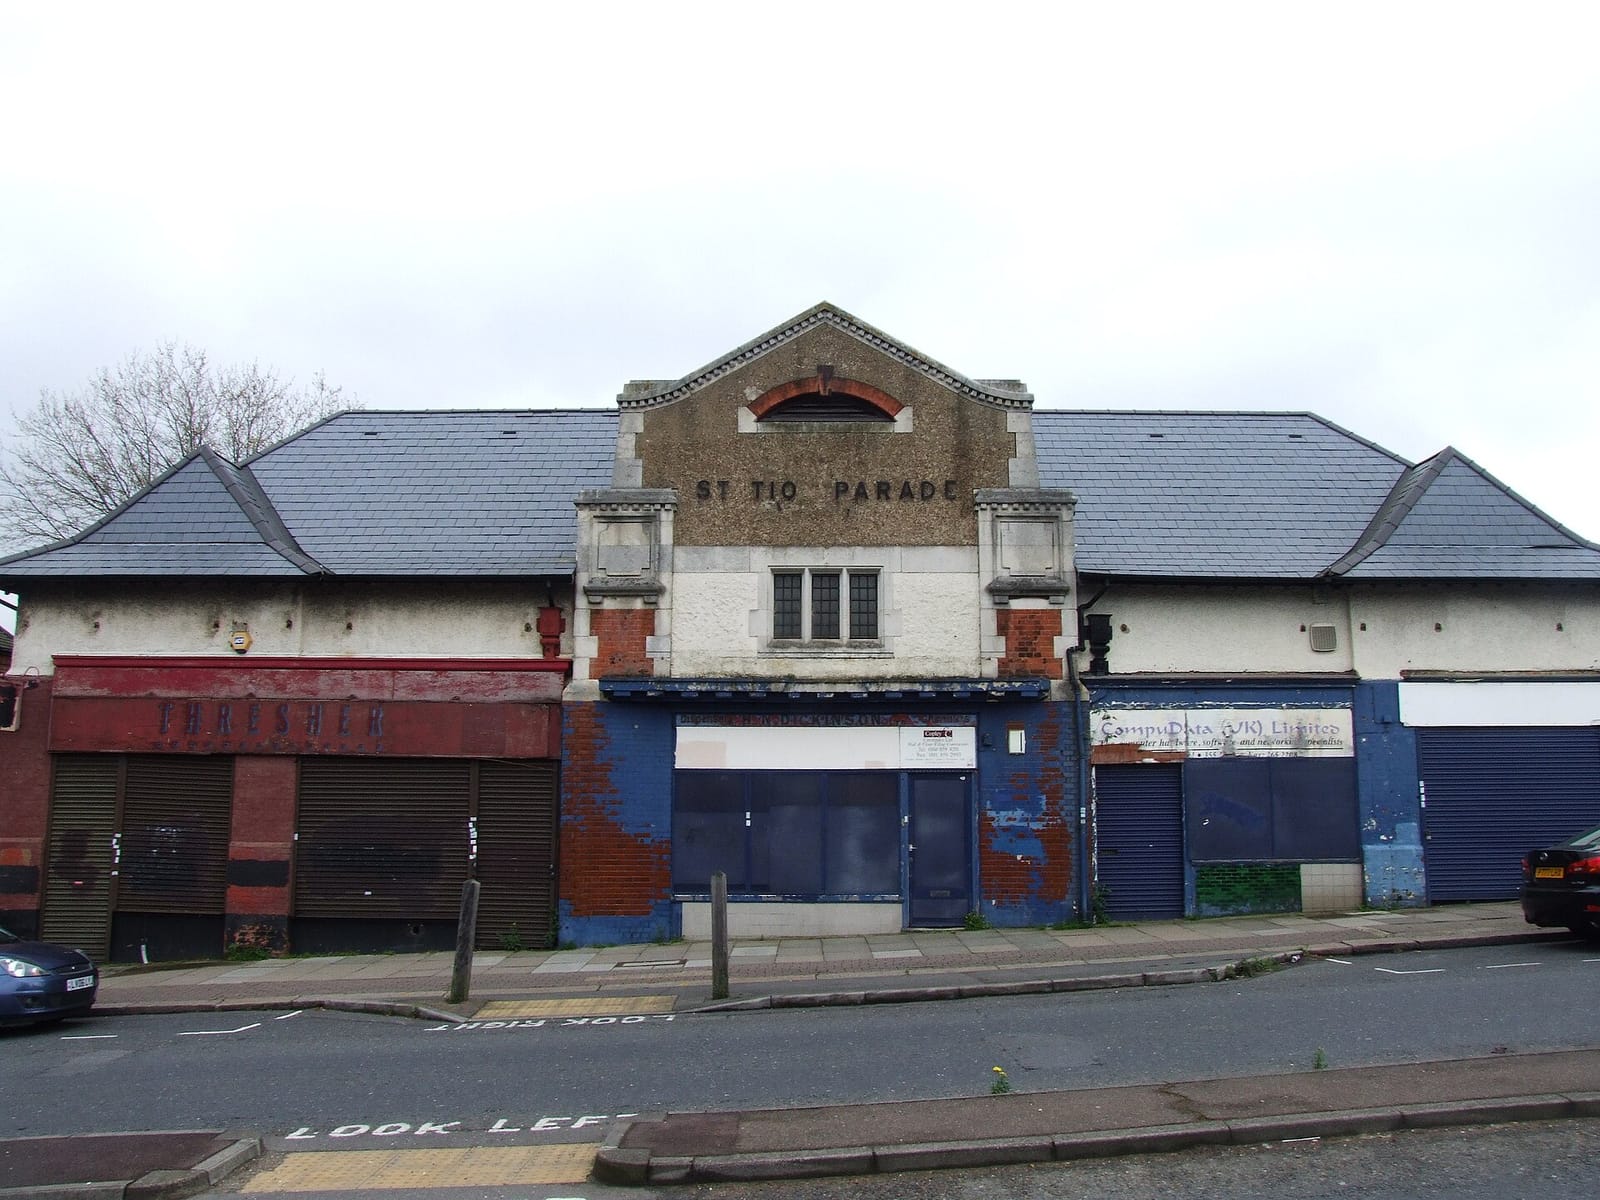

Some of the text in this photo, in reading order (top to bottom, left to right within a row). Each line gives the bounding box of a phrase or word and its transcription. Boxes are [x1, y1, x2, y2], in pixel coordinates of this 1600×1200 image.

[834, 480, 958, 501] PARADE
[159, 703, 383, 737] THRESHER
[1272, 720, 1340, 735] Limited
[424, 1014, 677, 1031] LOOK RIGHT
[284, 1122, 461, 1140] LOOK
